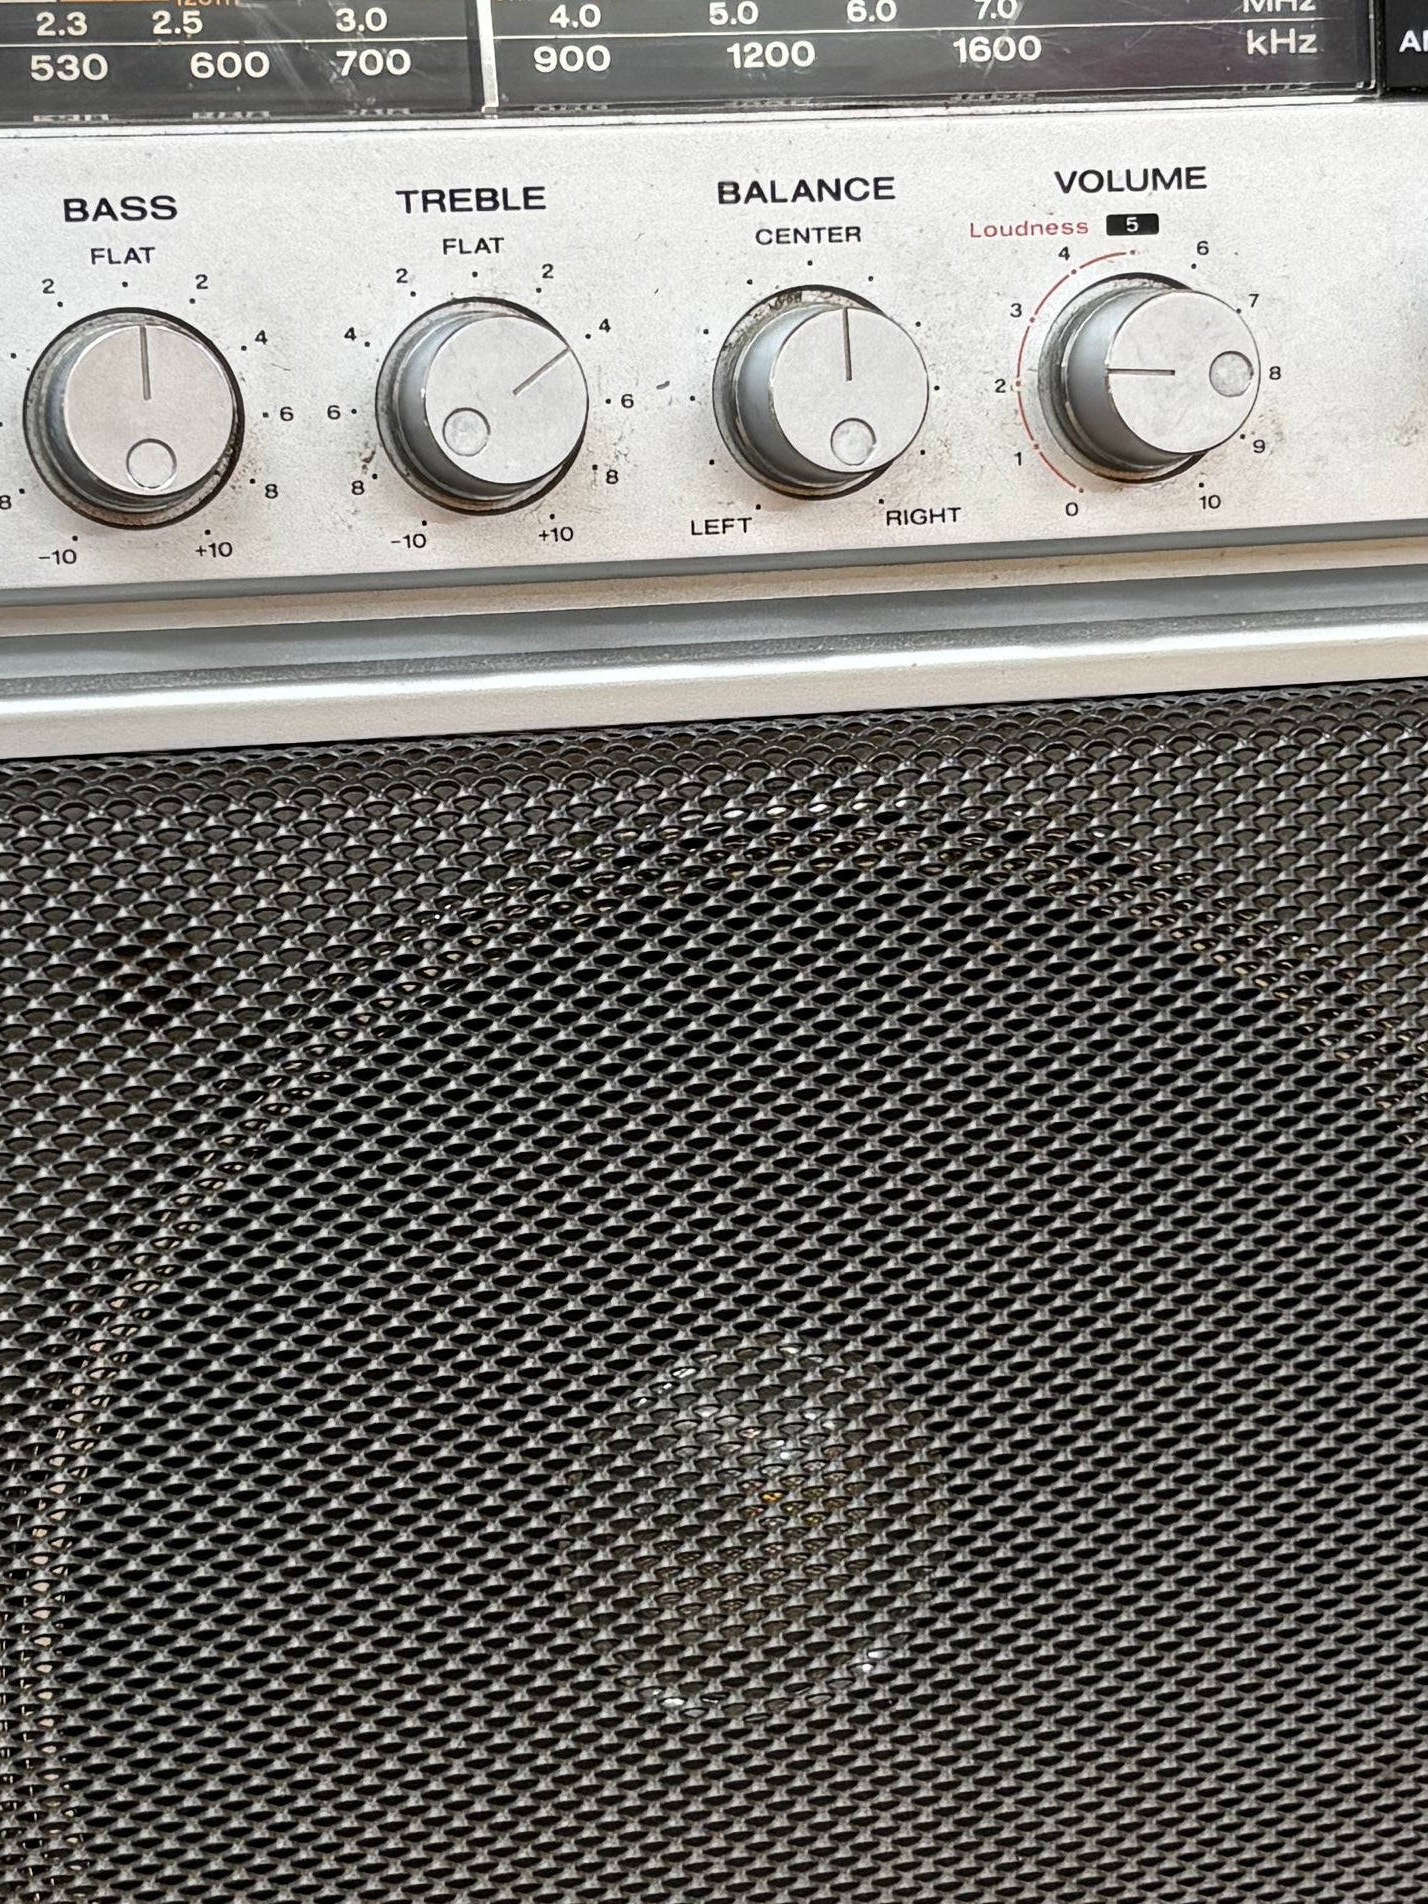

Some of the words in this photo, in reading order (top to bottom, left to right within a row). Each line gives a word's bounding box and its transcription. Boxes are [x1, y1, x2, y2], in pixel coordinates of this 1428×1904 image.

[35, 11, 88, 38] 2.3
[152, 9, 204, 36] 2.5
[334, 6, 388, 33] 3.0
[548, 2, 602, 29] 4.0
[708, 0, 759, 26] 5.0
[29, 52, 109, 82] 530
[189, 50, 270, 80] 600
[335, 47, 412, 77] 700
[532, 44, 612, 73] 900
[726, 39, 816, 70] 1200
[952, 34, 1043, 65] 1600
[1246, 27, 1318, 56] kHz
[1054, 165, 1208, 194] VOLUME
[717, 176, 897, 205] BALANCE
[395, 186, 548, 214] TREBLE
[63, 195, 179, 223] BASS
[969, 220, 1089, 238] Loudness
[1125, 217, 1139, 233] 5
[754, 226, 863, 246] CENTER
[442, 237, 505, 255] FLAT
[1057, 246, 1071, 262] 4
[1196, 240, 1210, 256] 6
[90, 246, 156, 265] FLAT
[395, 268, 409, 284] 2
[541, 263, 555, 280] 2
[41, 278, 56, 295] 2
[195, 273, 210, 290] 2
[1248, 293, 1260, 309] 7
[1009, 303, 1023, 319] 3
[598, 318, 612, 333] 4
[254, 330, 269, 345] 4
[343, 327, 357, 342] 4
[1268, 366, 1282, 381] 8
[994, 379, 1007, 394] 2
[620, 393, 635, 409] 6
[279, 406, 295, 422] 6
[326, 404, 342, 420] 6
[1252, 439, 1266, 454] 9
[1014, 452, 1022, 467] 1
[605, 469, 620, 485] 8
[264, 483, 279, 499] 8
[350, 480, 365, 496] 8
[1065, 502, 1079, 517] 0
[1198, 494, 1222, 510] 10
[885, 507, 962, 527] RIGHT
[537, 526, 575, 543] +10
[690, 517, 753, 537] LEFT
[195, 541, 234, 558] +10
